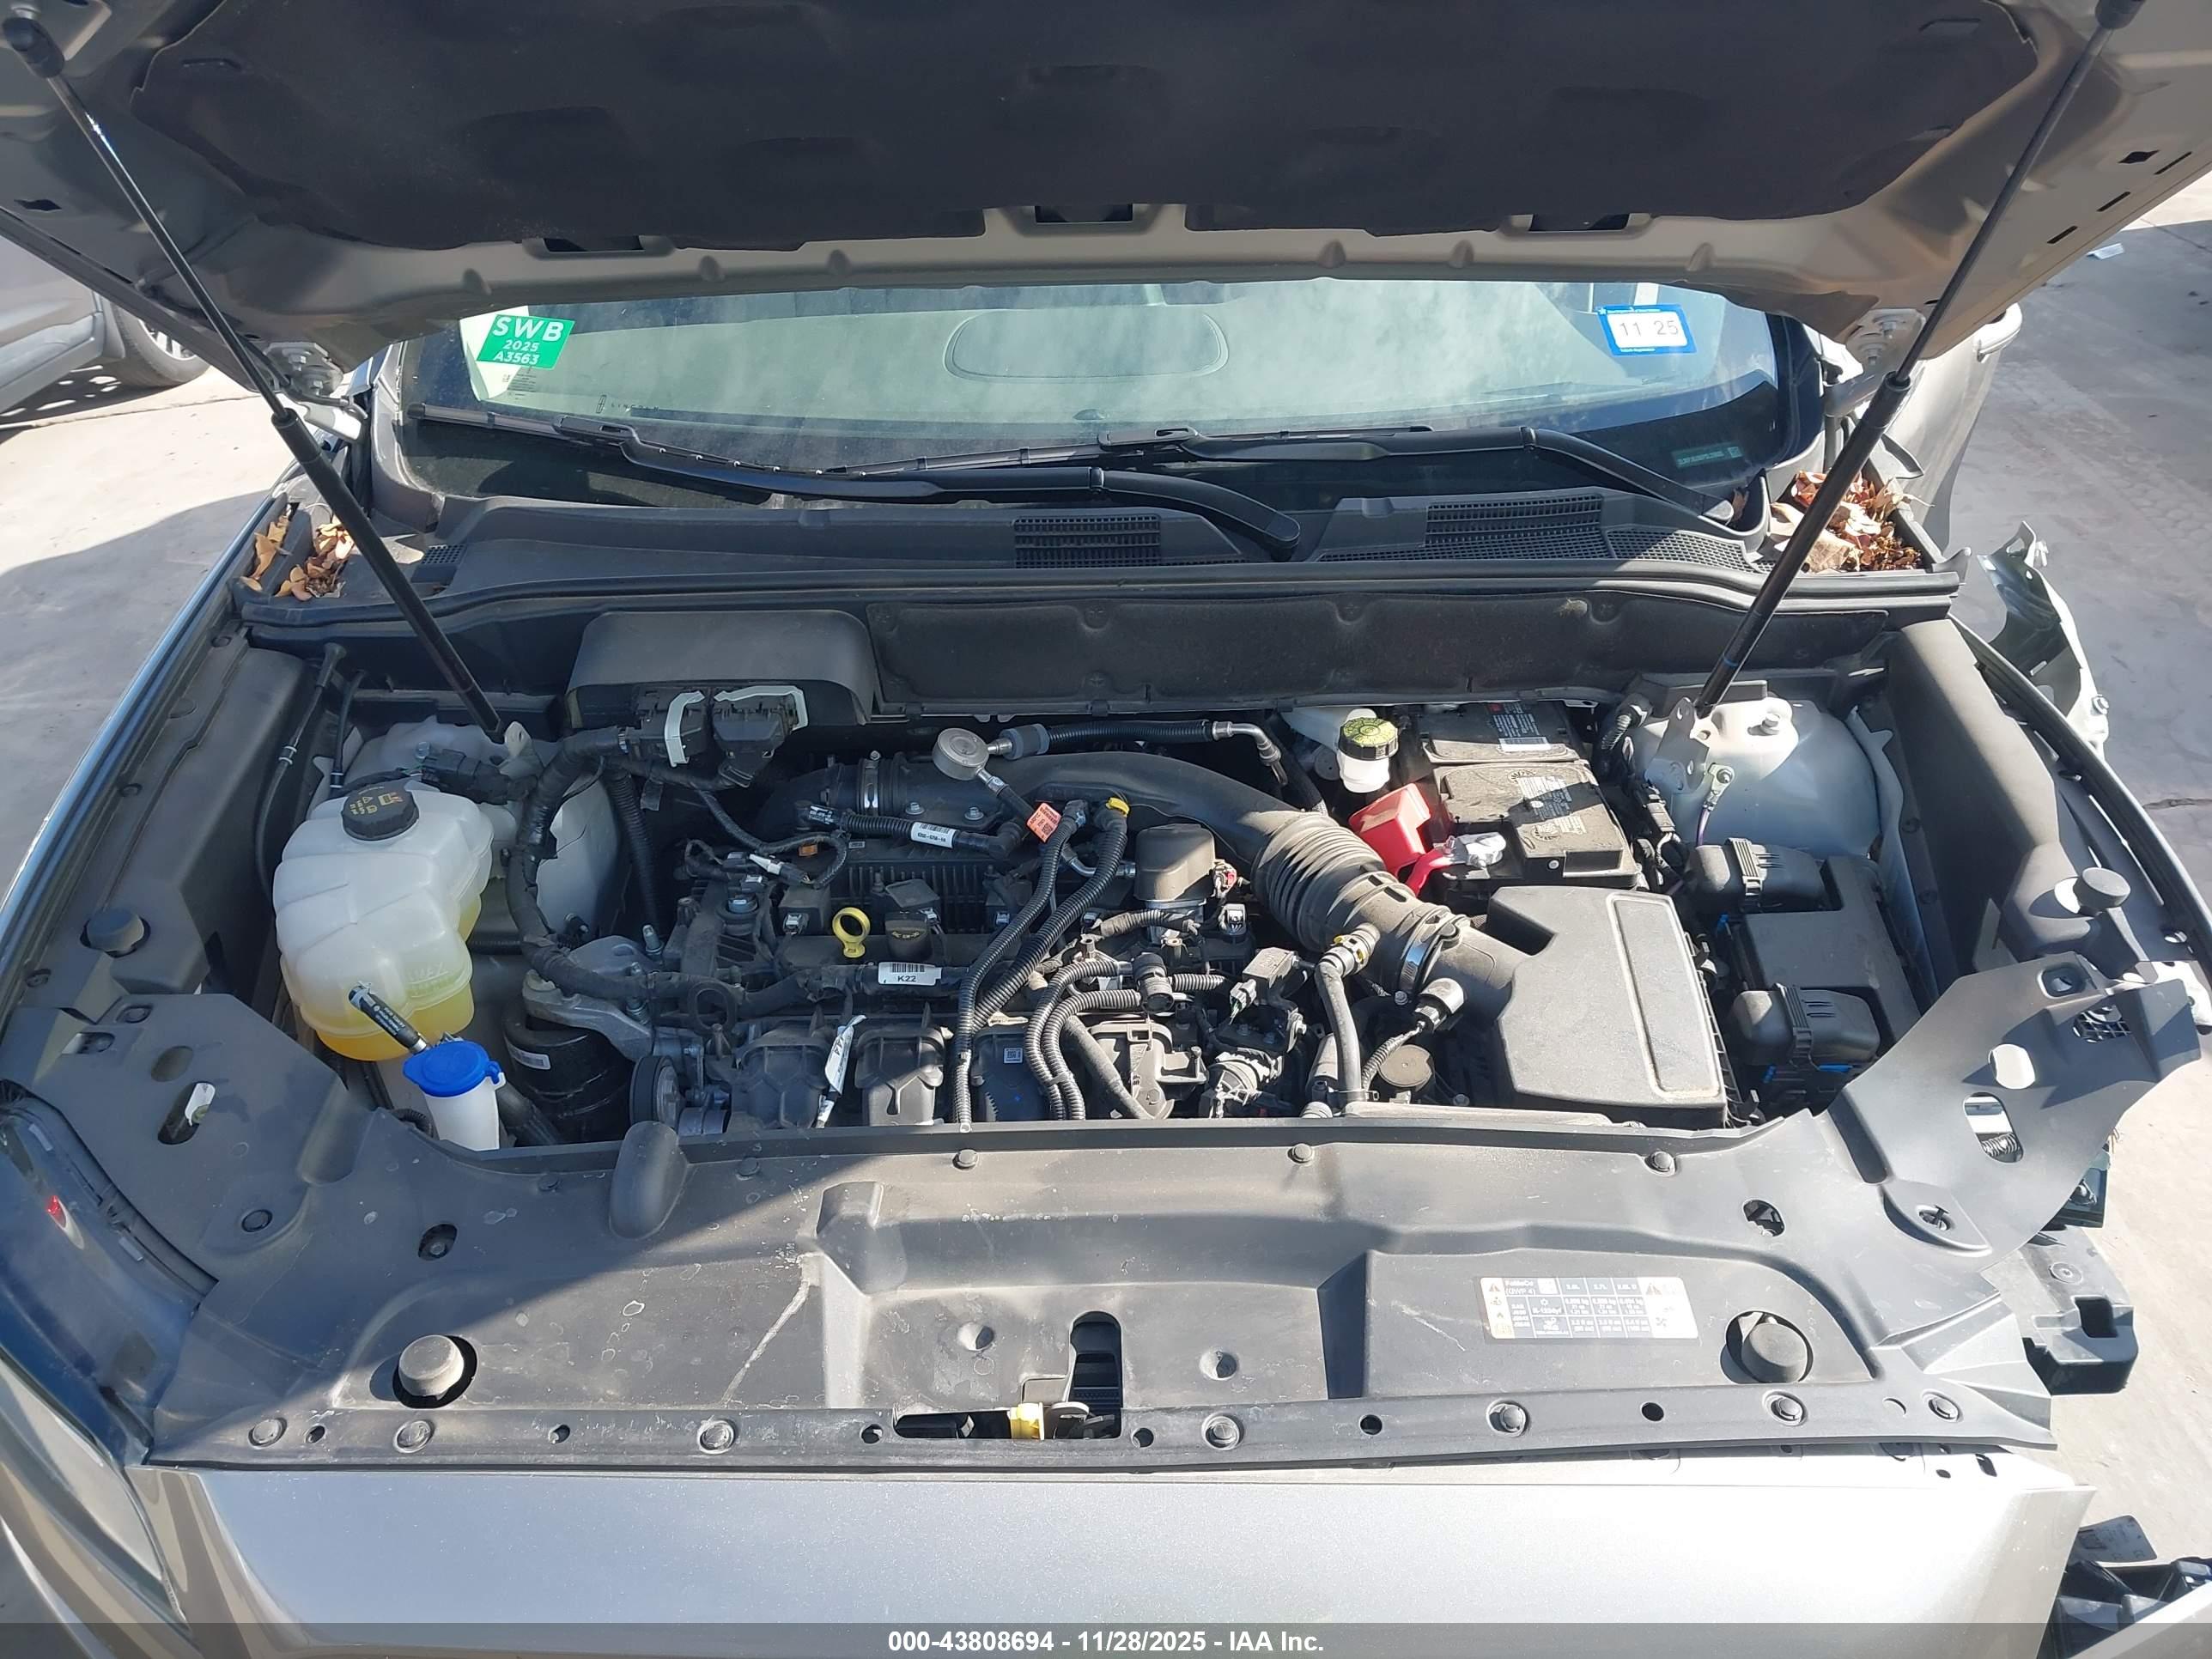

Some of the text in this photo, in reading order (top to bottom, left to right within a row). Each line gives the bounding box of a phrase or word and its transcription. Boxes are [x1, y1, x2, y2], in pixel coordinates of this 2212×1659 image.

[493, 317, 564, 342] SWB
[1620, 319, 1679, 337] 11 25
[503, 340, 540, 351] 2025
[494, 352, 540, 365] A3563
